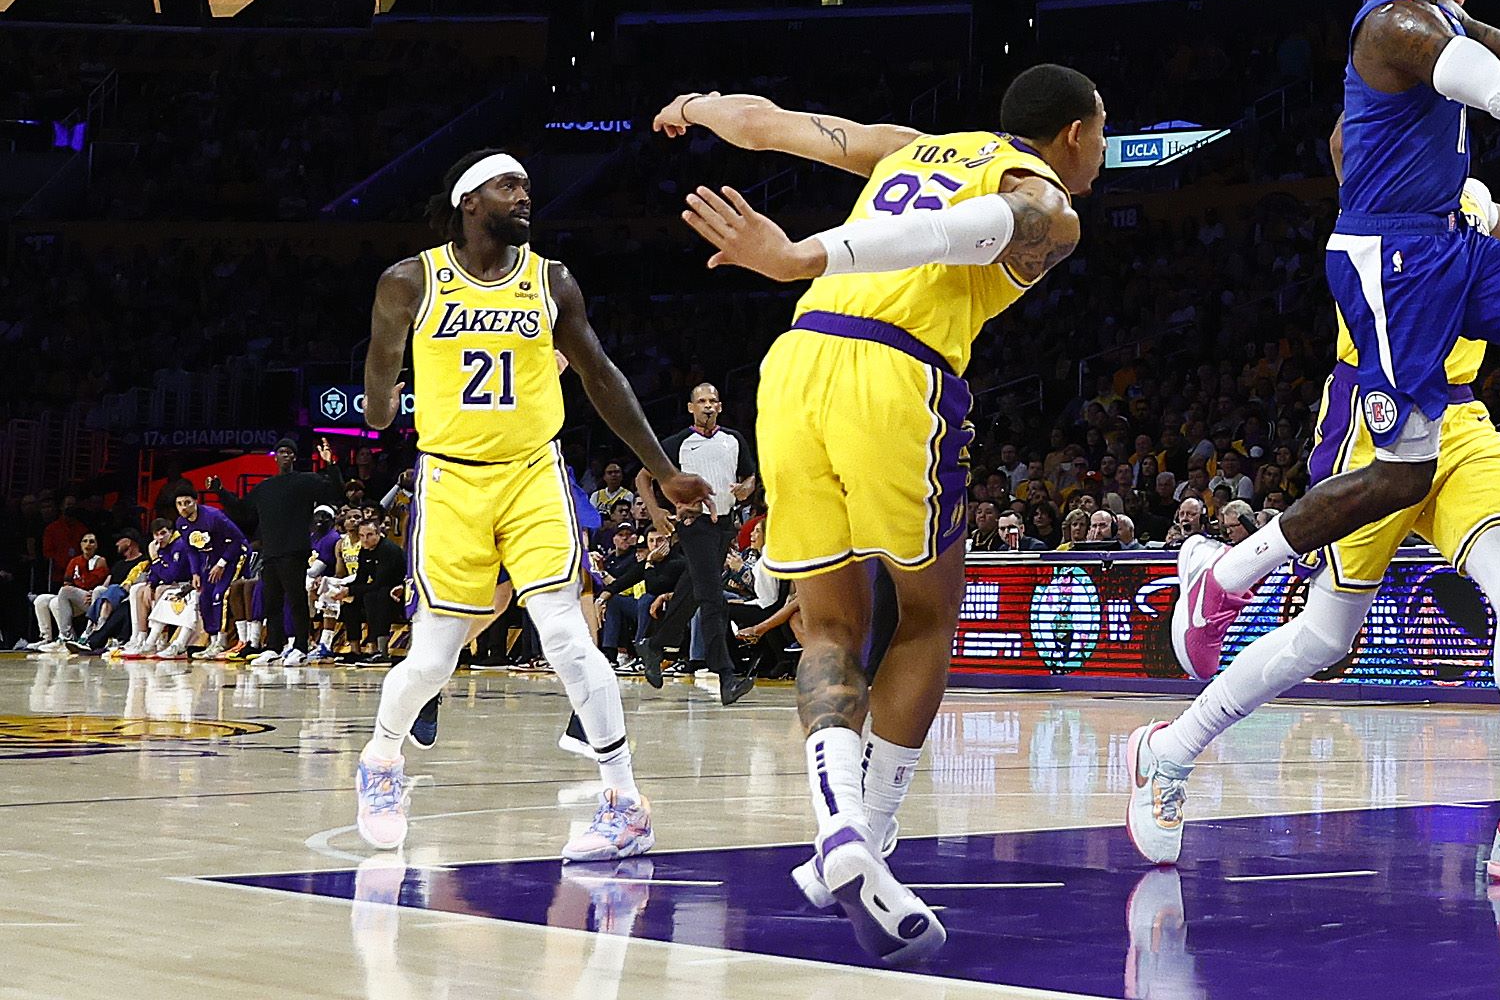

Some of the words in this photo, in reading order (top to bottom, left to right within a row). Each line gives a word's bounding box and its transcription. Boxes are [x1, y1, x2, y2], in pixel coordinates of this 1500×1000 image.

[1126, 142, 1159, 157] UCLA
[439, 269, 451, 282] 6
[432, 302, 540, 338] LAKERS
[461, 349, 516, 409] 21
[172, 429, 278, 446] CHAMPIONS
